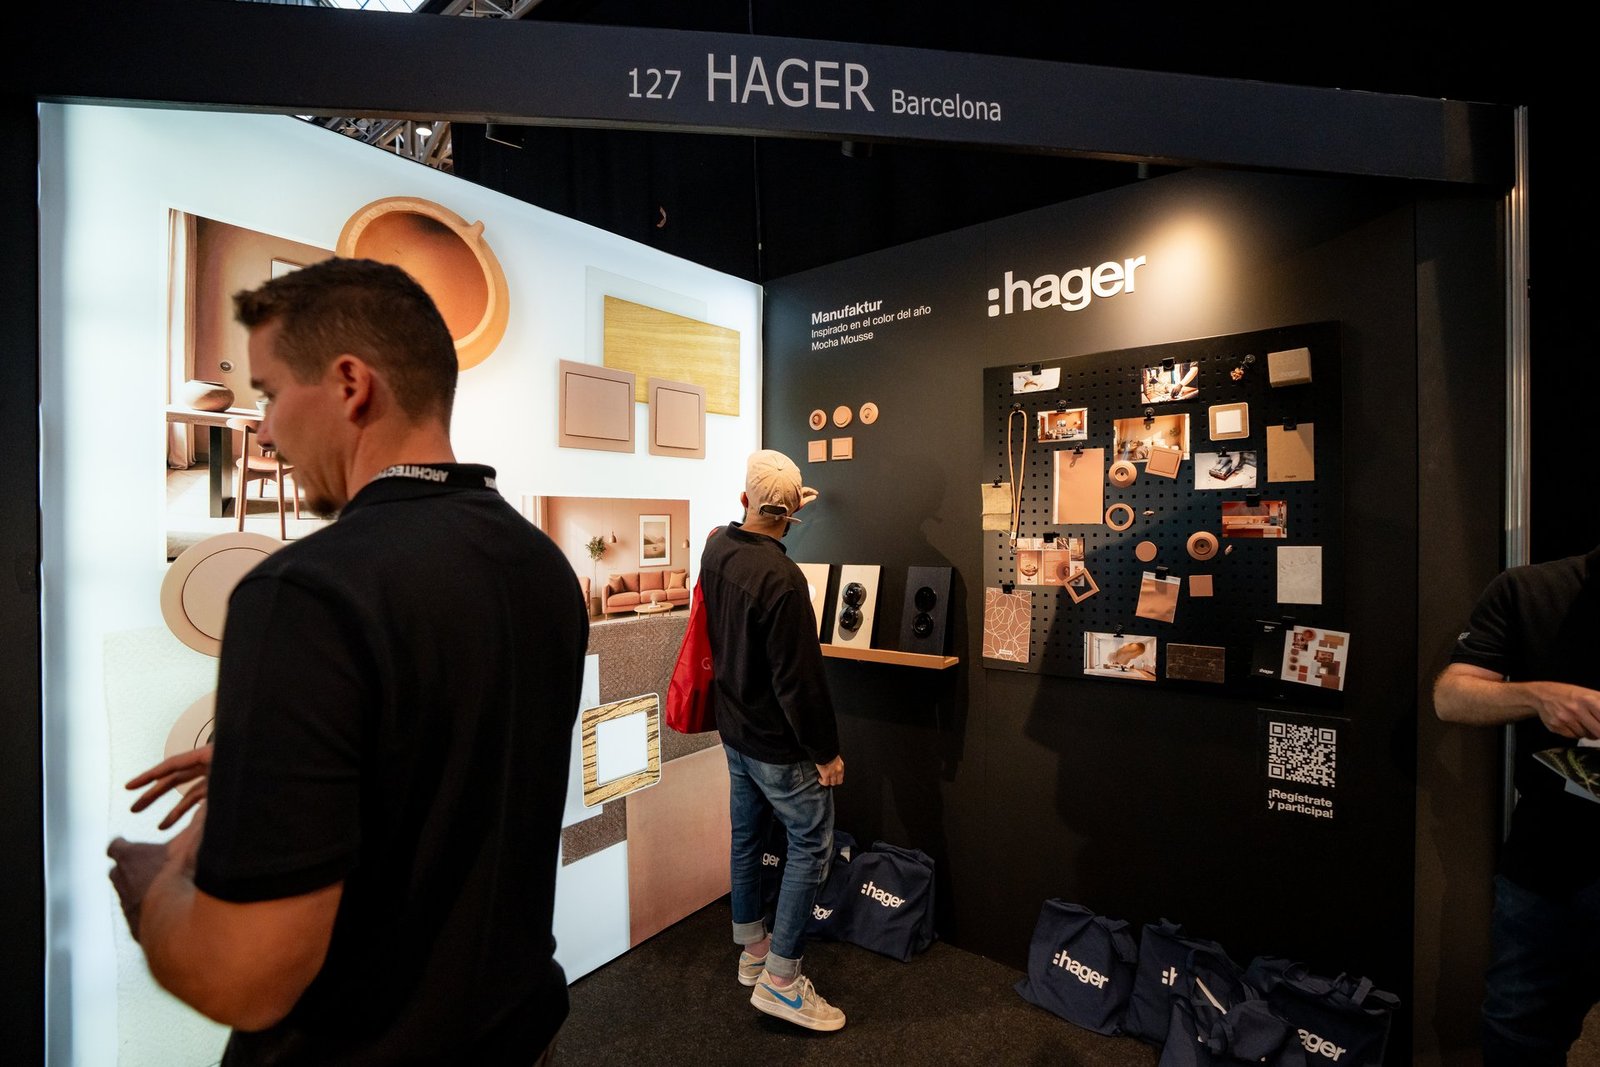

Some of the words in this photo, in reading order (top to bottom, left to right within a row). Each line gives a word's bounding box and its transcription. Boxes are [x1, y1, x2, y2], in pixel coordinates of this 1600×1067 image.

[628, 67, 682, 100] 127
[707, 53, 875, 112] HAGER
[891, 89, 1002, 122] Barcelona
[811, 299, 883, 325] Manufaktur
[811, 322, 848, 339] Inspirado
[850, 320, 861, 330] en
[862, 317, 871, 327] el
[872, 313, 895, 326] color
[897, 308, 911, 320] del
[913, 305, 932, 317] año
[811, 337, 839, 351] Mocha
[840, 331, 874, 345] Mousse
[1268, 788, 1333, 808] ¡Regístrate
[1268, 800, 1275, 809] y
[1277, 801, 1334, 819] participa!
[762, 852, 780, 867] ger
[1297, 1028, 1347, 1062] ager
